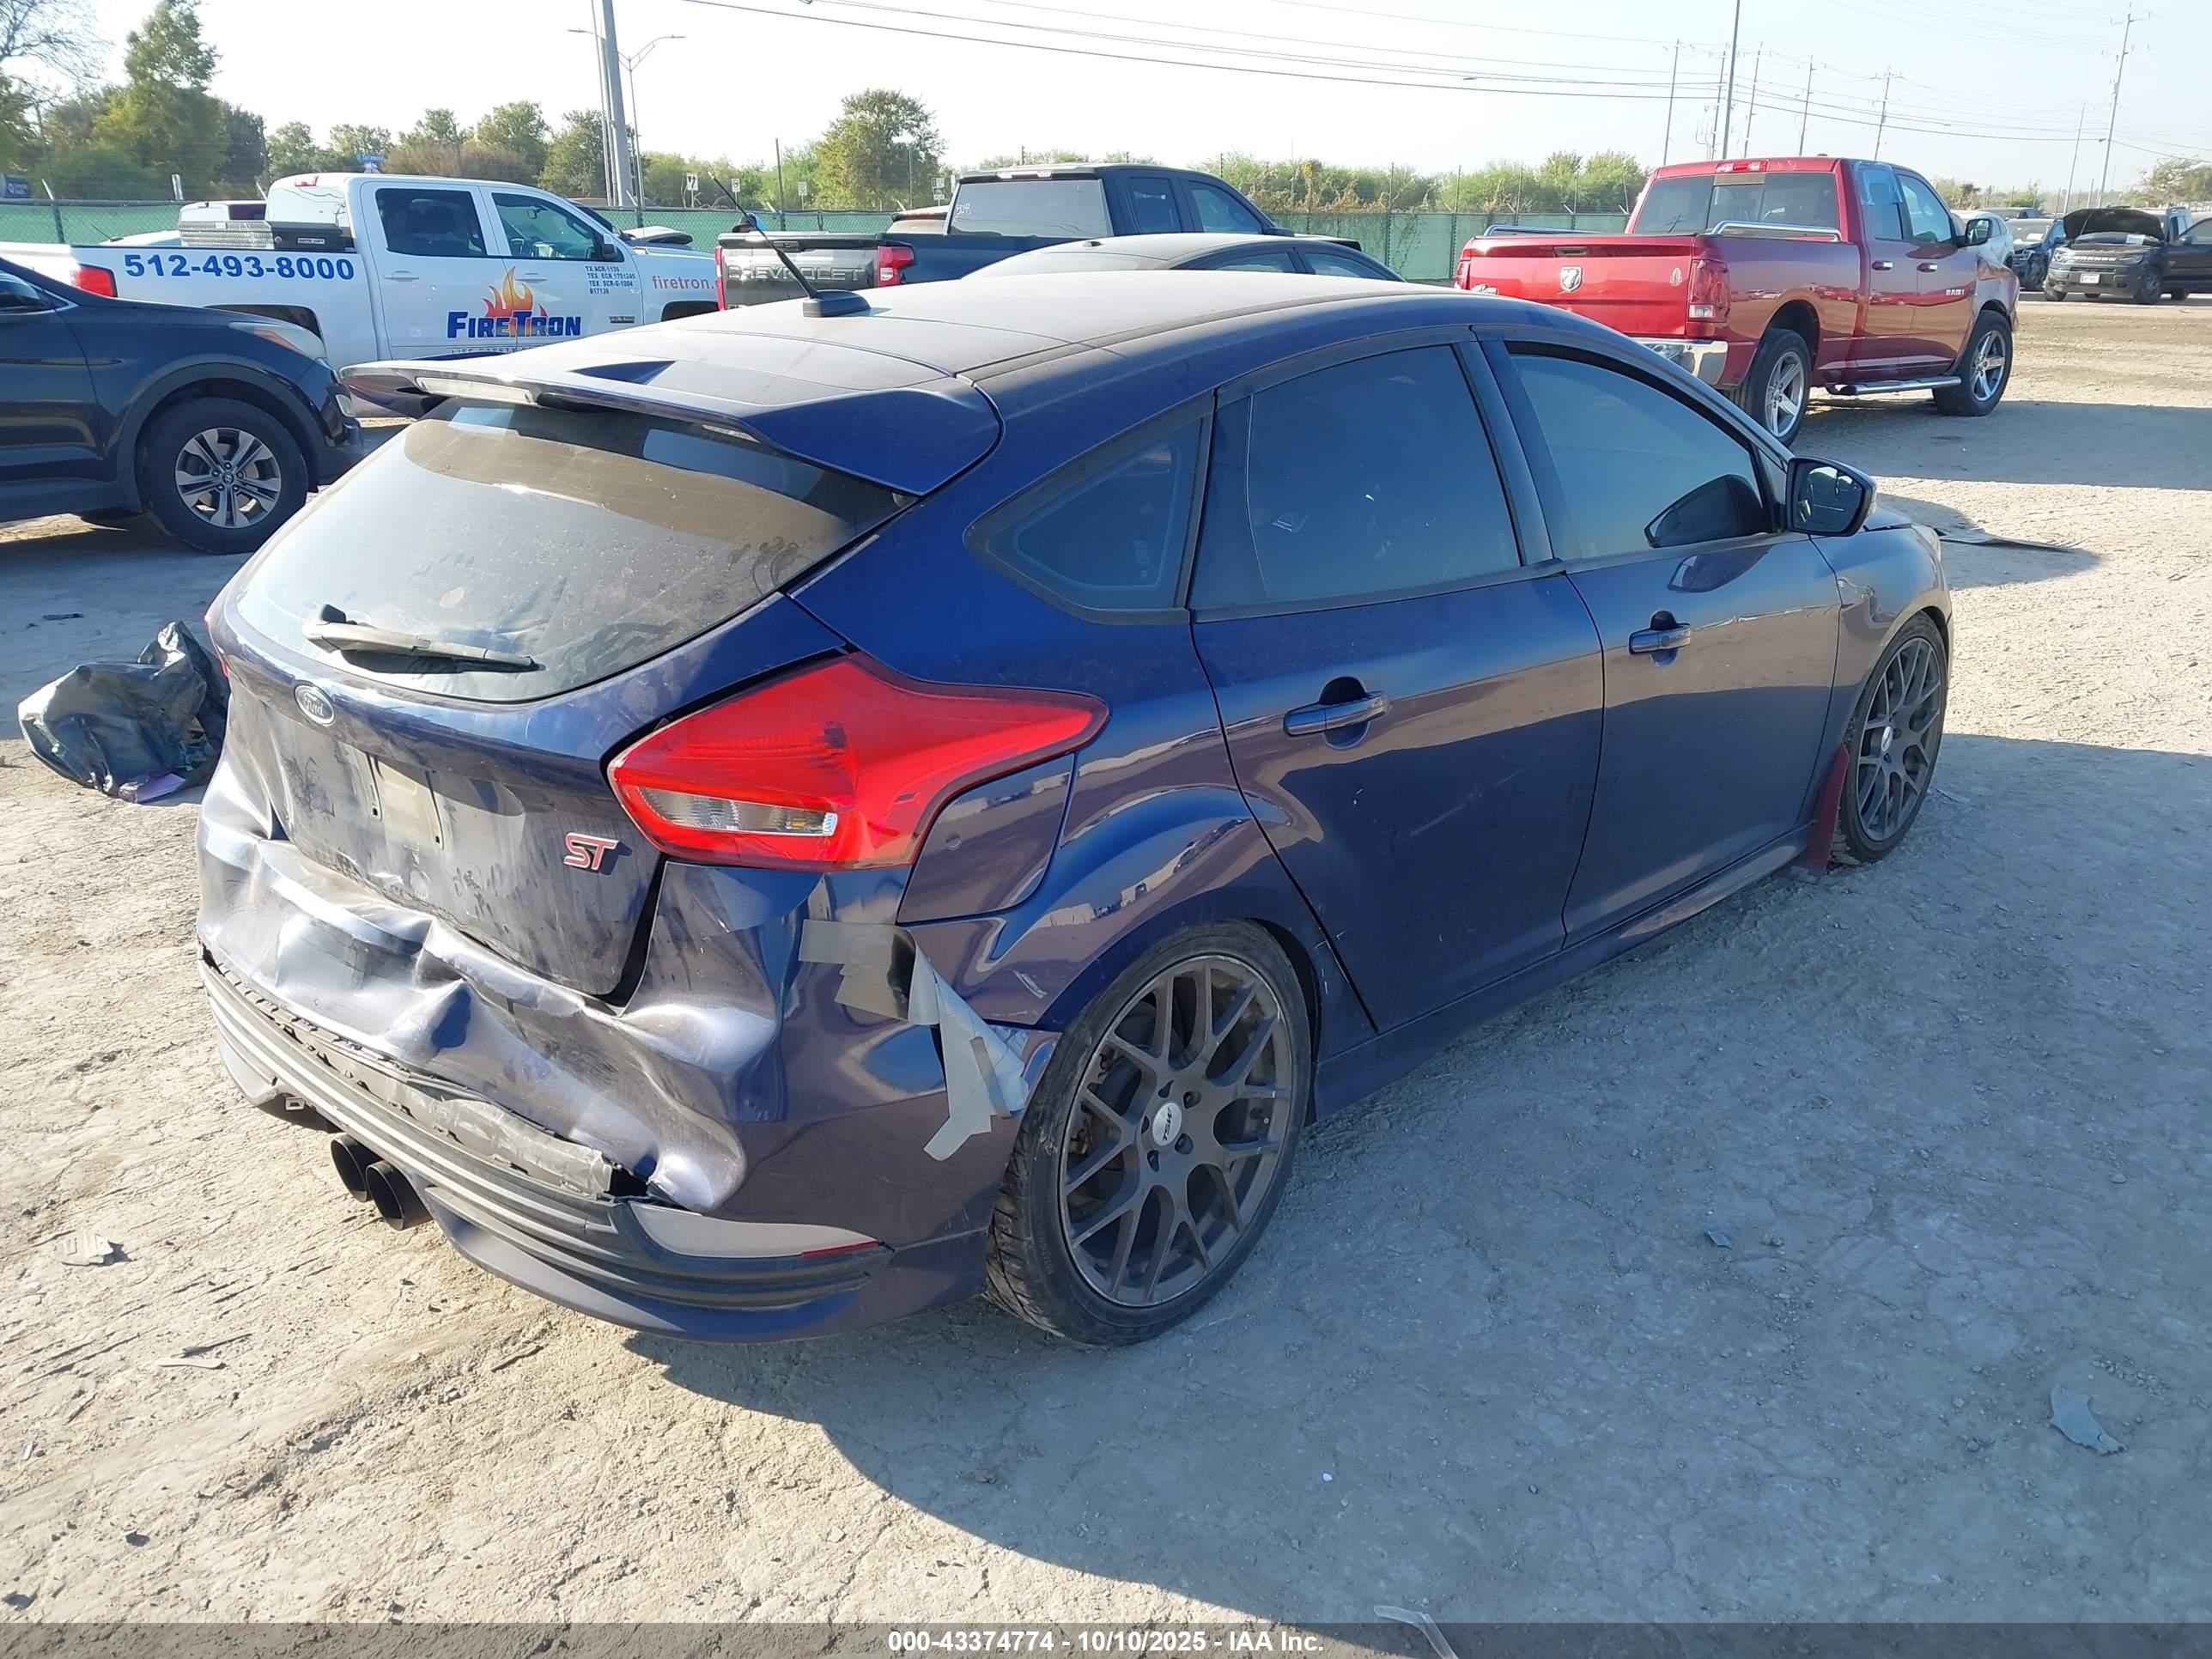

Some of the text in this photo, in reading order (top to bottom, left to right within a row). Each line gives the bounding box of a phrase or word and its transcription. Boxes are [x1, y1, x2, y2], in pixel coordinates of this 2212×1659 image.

[124, 254, 354, 280] 512-493-8000
[652, 275, 718, 289] firetron.
[563, 832, 618, 870] ST
